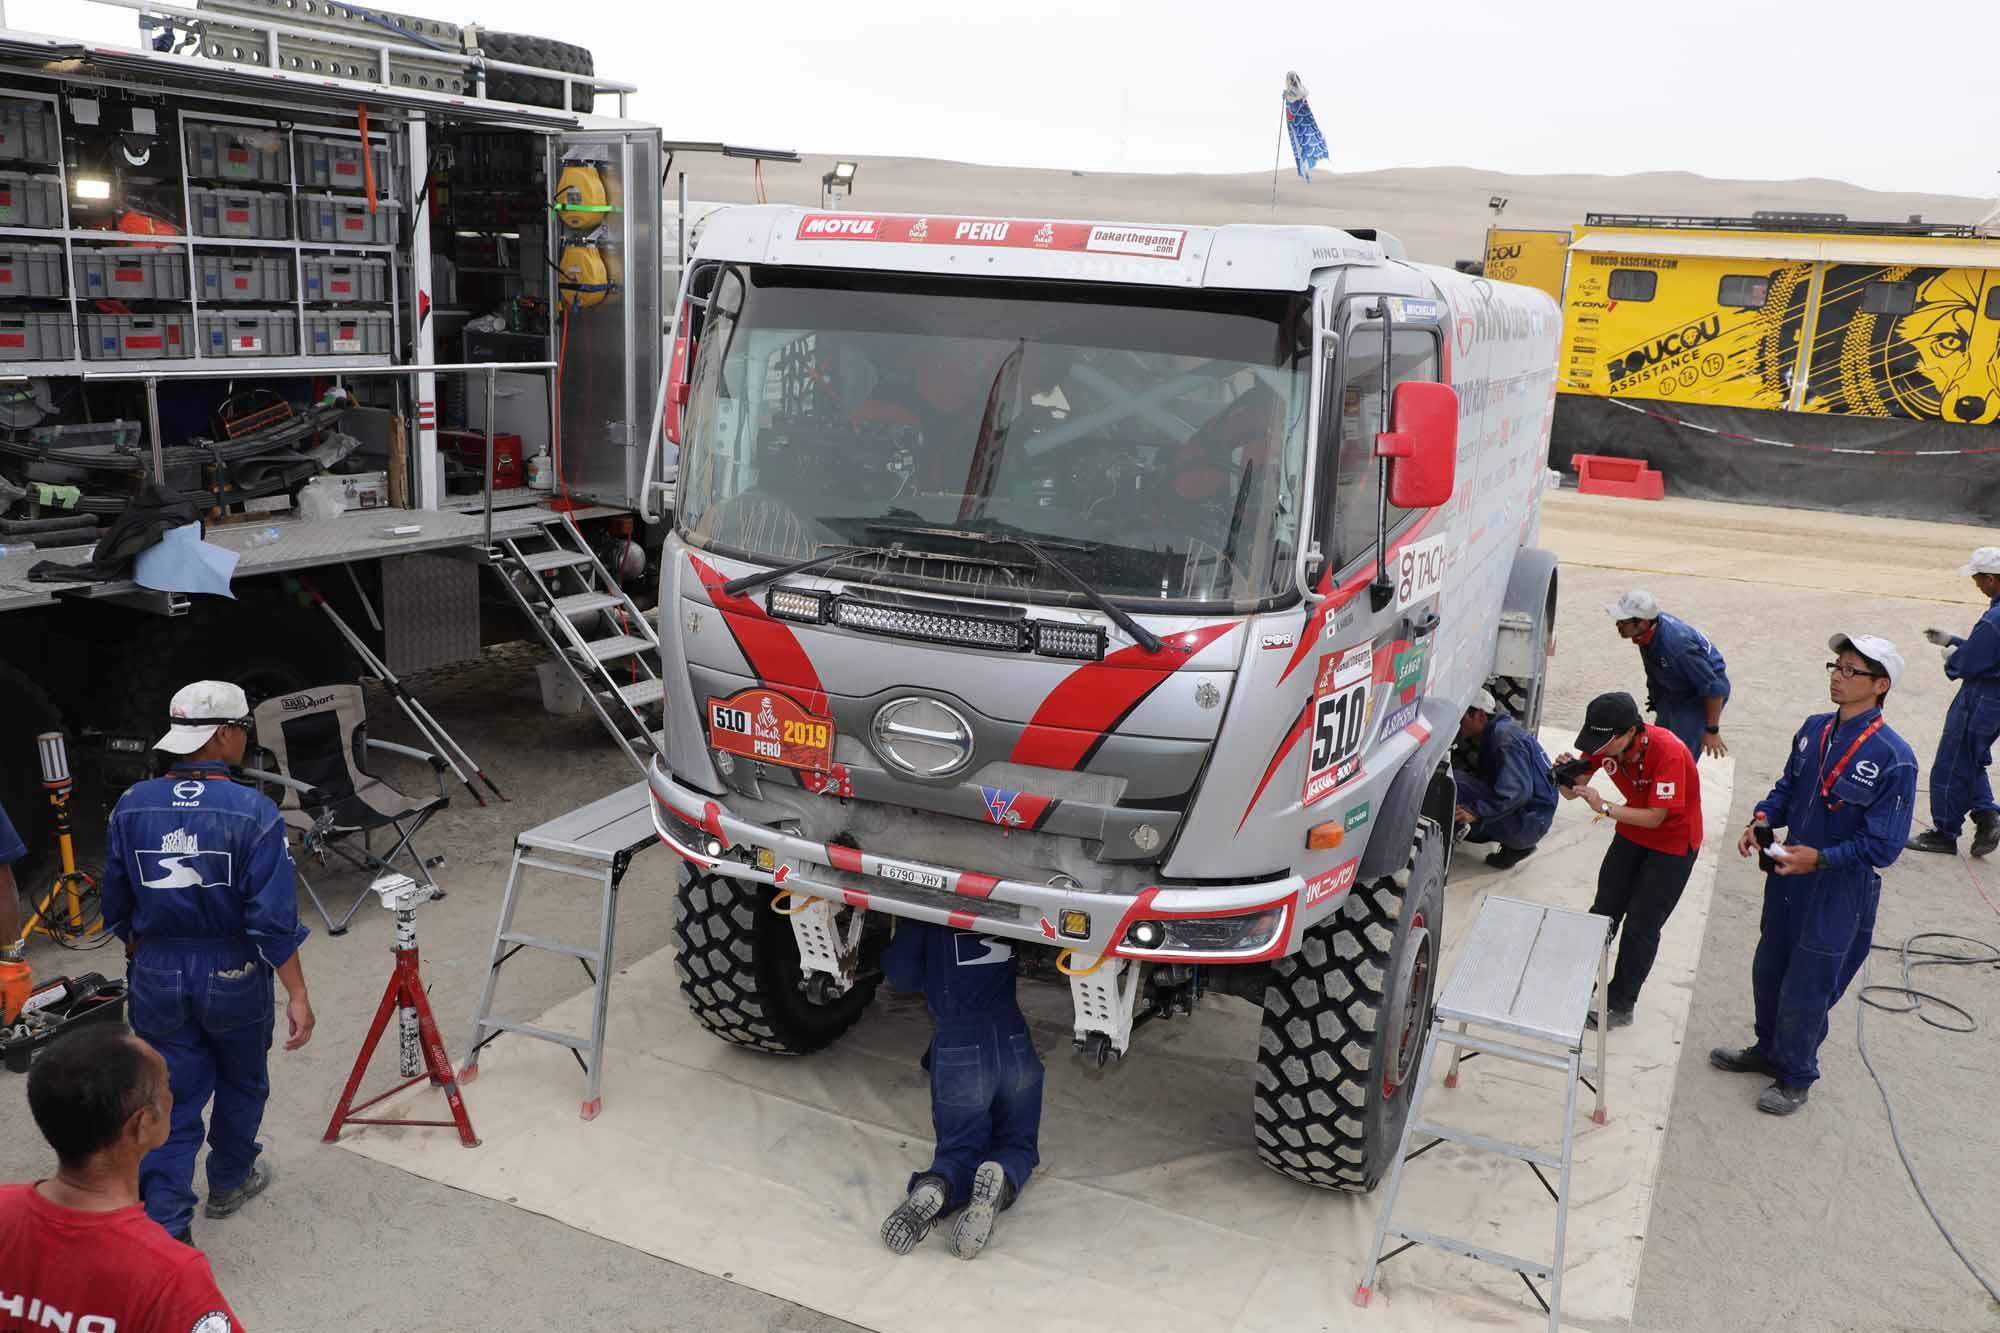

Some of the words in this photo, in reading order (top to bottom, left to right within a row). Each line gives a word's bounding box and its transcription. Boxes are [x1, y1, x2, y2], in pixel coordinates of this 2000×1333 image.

[805, 219, 875, 234] MOTUL
[955, 220, 1009, 241] PERÚ
[1094, 231, 1176, 247] Dakarthegame
[1154, 245, 1174, 254] .com
[1607, 315, 1720, 382] BOUCOU
[1610, 349, 1700, 395] ASSISTANCE
[716, 706, 746, 733] 510
[1312, 687, 1366, 772] 510
[783, 720, 827, 749] 2019
[753, 740, 781, 757] PERÚ
[889, 868, 915, 882] 6790
[0, 1291, 117, 1333] HINO
